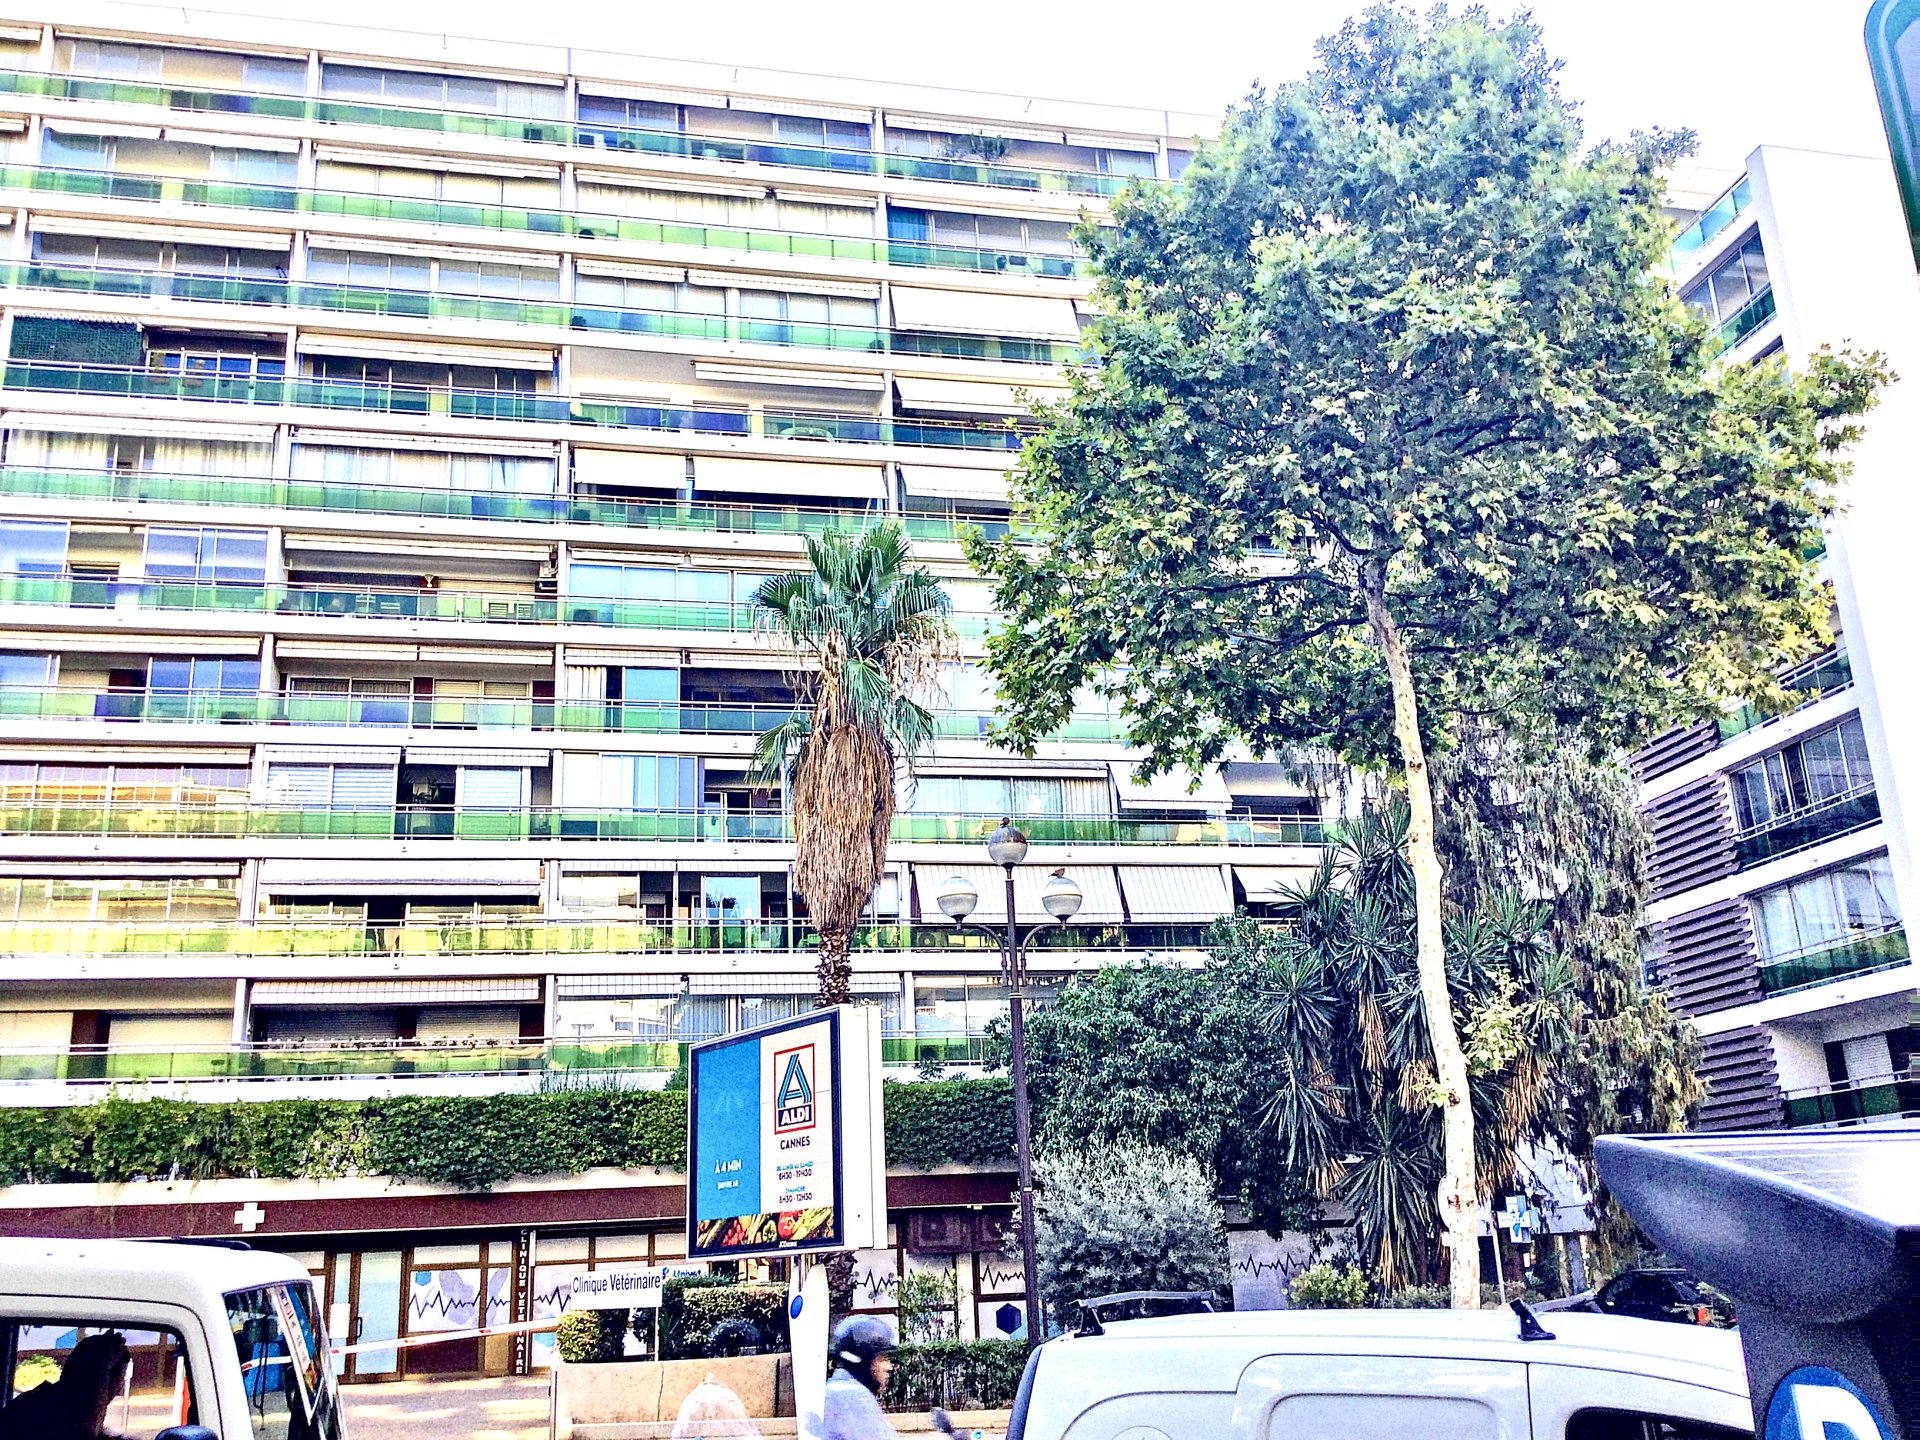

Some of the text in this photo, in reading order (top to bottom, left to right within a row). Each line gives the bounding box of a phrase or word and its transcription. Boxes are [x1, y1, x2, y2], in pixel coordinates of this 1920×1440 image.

[781, 1106, 810, 1126] ALDI
[780, 1135, 810, 1150] CANNES
[728, 1159, 742, 1172] MIN
[779, 1171, 792, 1180] 8H30
[796, 1168, 812, 1178] 19H30
[779, 1195, 792, 1204] 8H30
[572, 1271, 661, 1296] Clinique Vétérinaire
[515, 1228, 528, 1374] CLINIQUE VETEINAIRE
